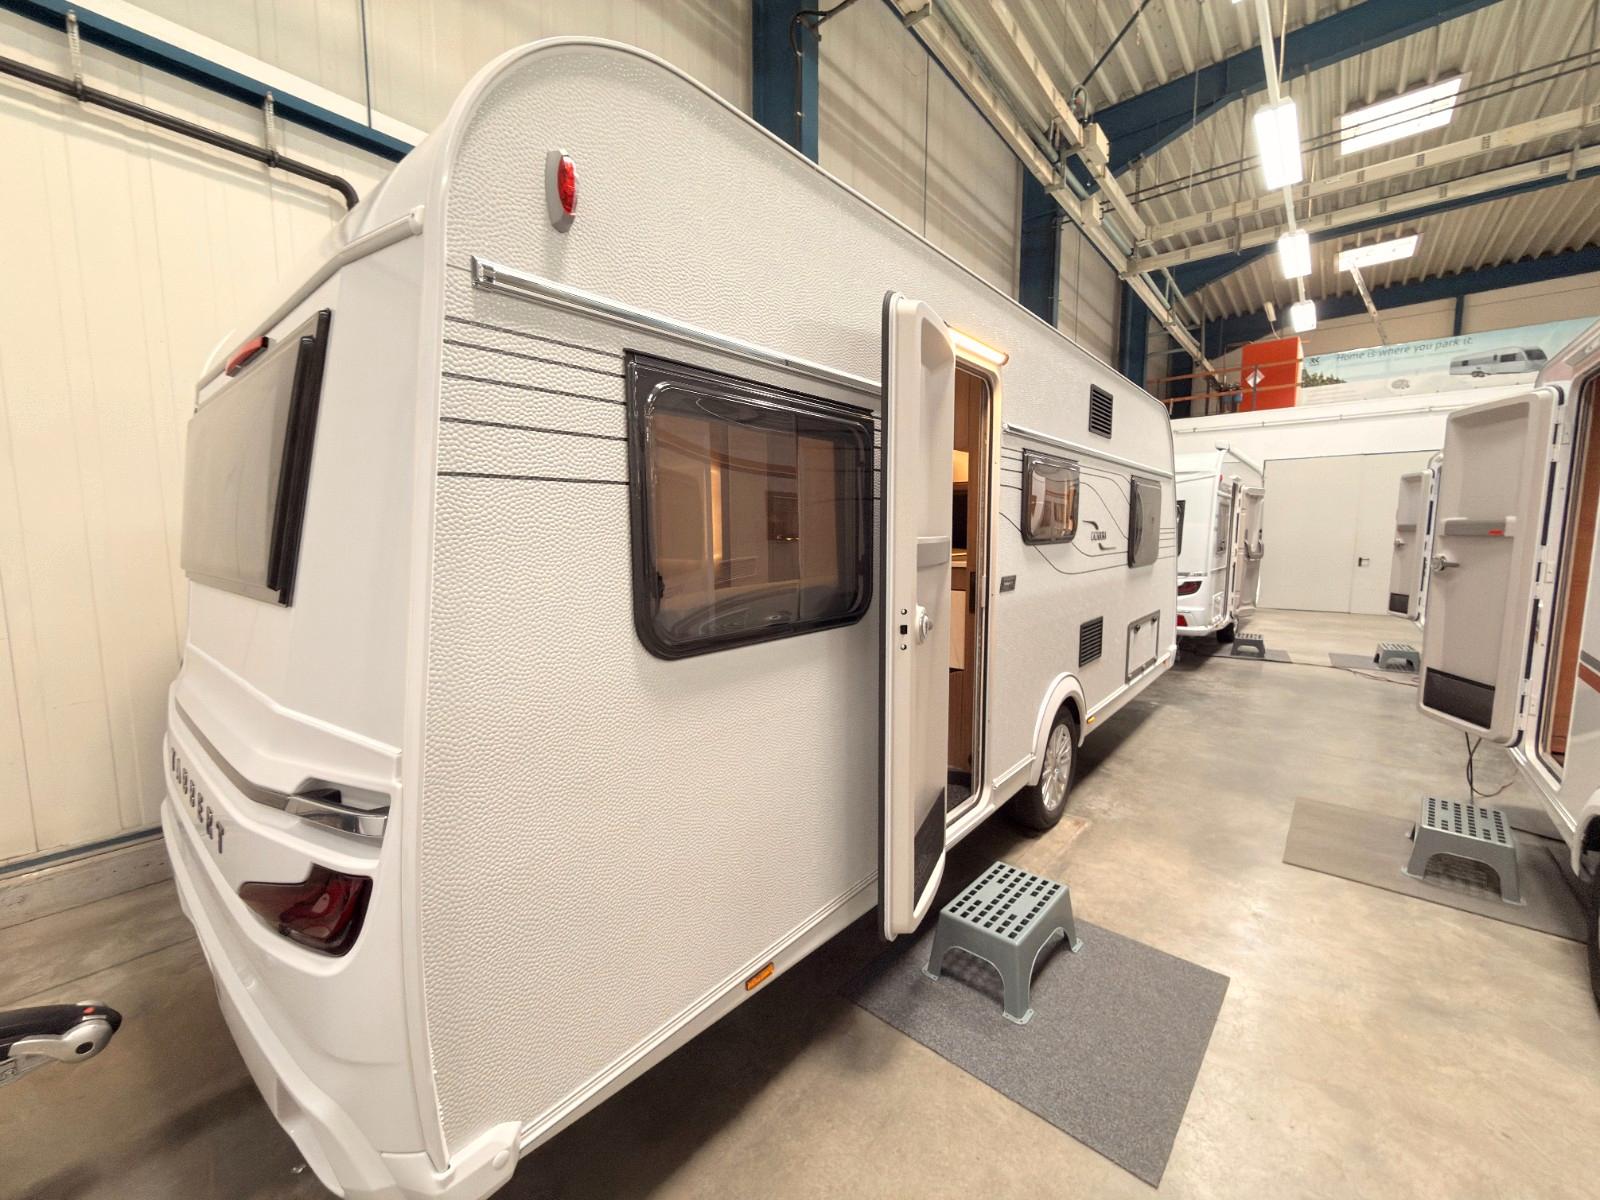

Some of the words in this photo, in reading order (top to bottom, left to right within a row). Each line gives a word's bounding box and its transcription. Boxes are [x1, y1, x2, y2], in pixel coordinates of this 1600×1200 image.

[1336, 353, 1365, 361] Home
[1378, 345, 1409, 357] where
[1414, 343, 1433, 353] you
[1435, 339, 1458, 351] park
[171, 747, 224, 855] TABBERT
